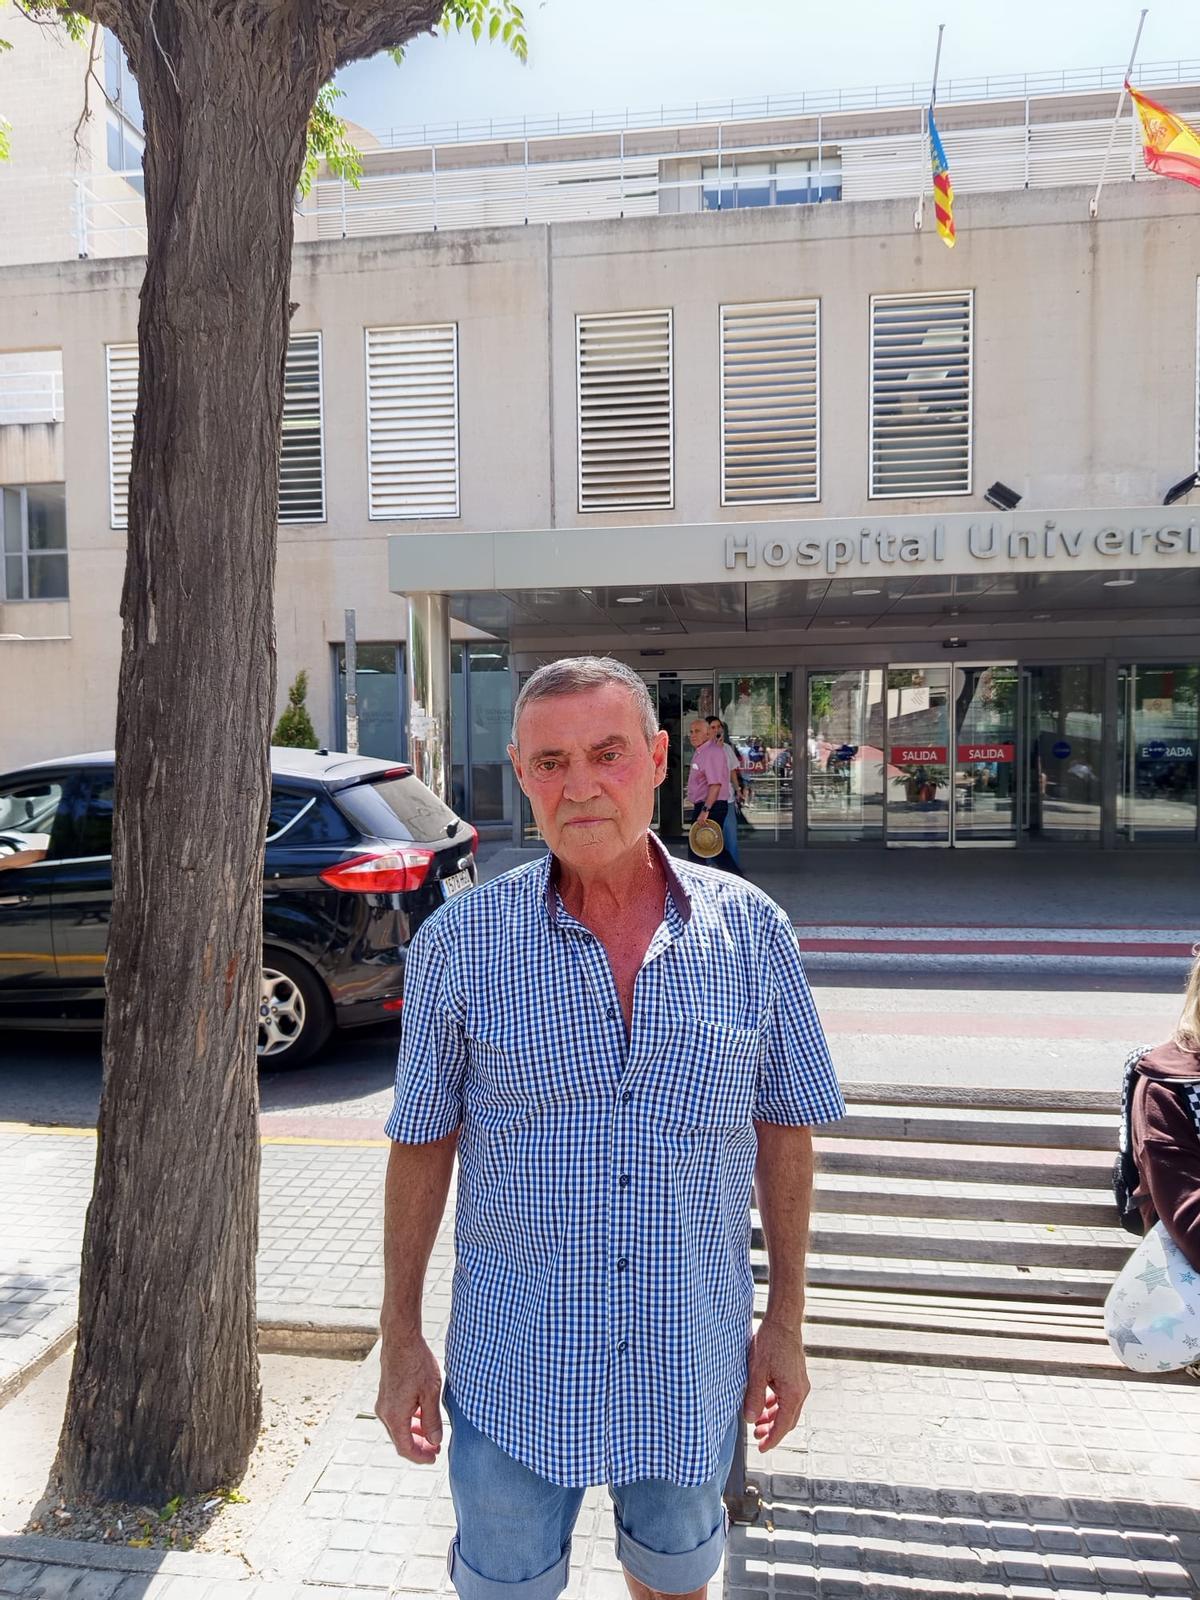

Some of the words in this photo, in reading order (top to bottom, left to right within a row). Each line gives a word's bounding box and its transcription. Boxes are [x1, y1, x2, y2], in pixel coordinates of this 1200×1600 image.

[725, 523, 945, 574] Hospital
[968, 517, 1200, 559] Universi
[902, 751, 938, 761] SALIDA
[968, 749, 1005, 760] SALIDA
[1142, 746, 1193, 758] ERADA
